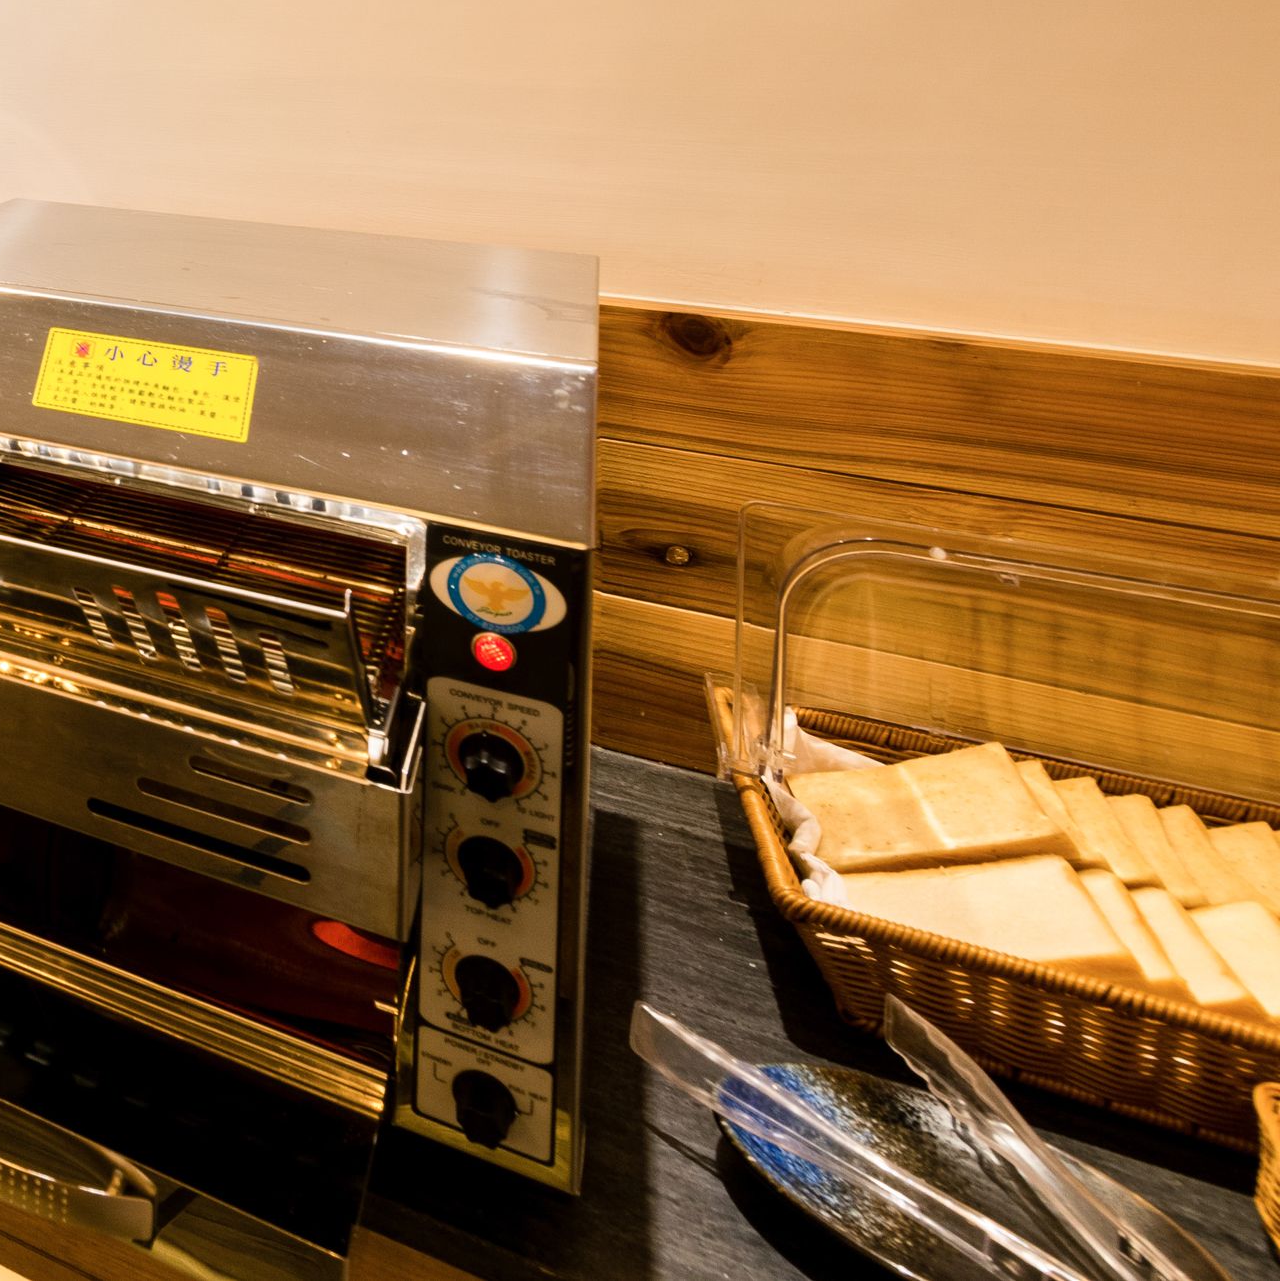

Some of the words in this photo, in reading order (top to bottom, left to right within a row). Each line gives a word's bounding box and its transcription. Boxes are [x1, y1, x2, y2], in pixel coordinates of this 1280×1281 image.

[104, 345, 228, 377] 小心燙手
[442, 535, 502, 556] CONVEYOR
[505, 547, 557, 567] TOASTER
[449, 687, 503, 709] CONVEYOR
[507, 702, 541, 717] SPEED
